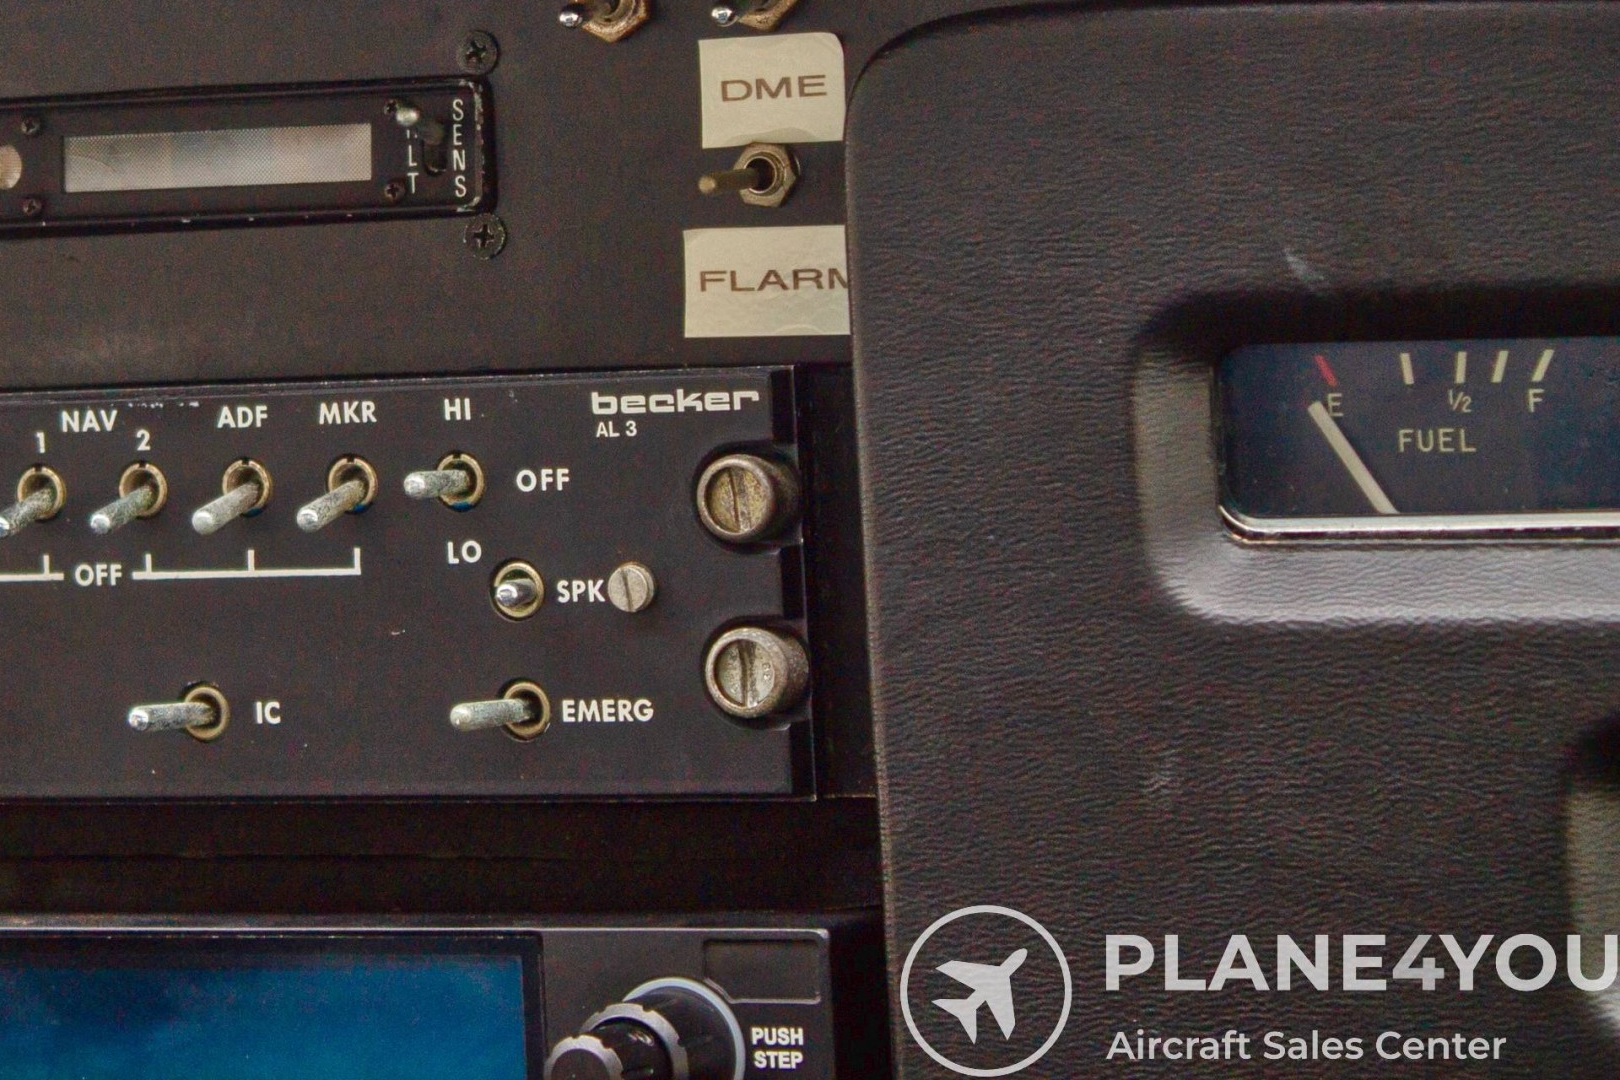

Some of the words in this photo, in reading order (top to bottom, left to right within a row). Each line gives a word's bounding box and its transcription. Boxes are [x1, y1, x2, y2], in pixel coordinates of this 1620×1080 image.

[720, 74, 828, 103] DME
[452, 98, 468, 198] SENS
[443, 398, 472, 422] HI
[590, 388, 760, 416] becker
[1325, 392, 1344, 418] E
[1527, 387, 1545, 414] F
[61, 409, 118, 433] NAV
[216, 405, 268, 430] ADF
[318, 401, 378, 426] MKR
[136, 429, 152, 452] 2
[595, 422, 621, 438] AL
[625, 420, 638, 438] 3
[1398, 428, 1478, 453] FUEL
[36, 431, 47, 455] 1
[515, 468, 571, 493] OFF
[446, 540, 482, 566] LO
[74, 563, 124, 588] OFF
[556, 579, 607, 605] SPK
[255, 700, 281, 726] IC
[561, 698, 655, 724] EMERG
[750, 1026, 805, 1047] PUSH
[753, 1049, 805, 1070] STEP
